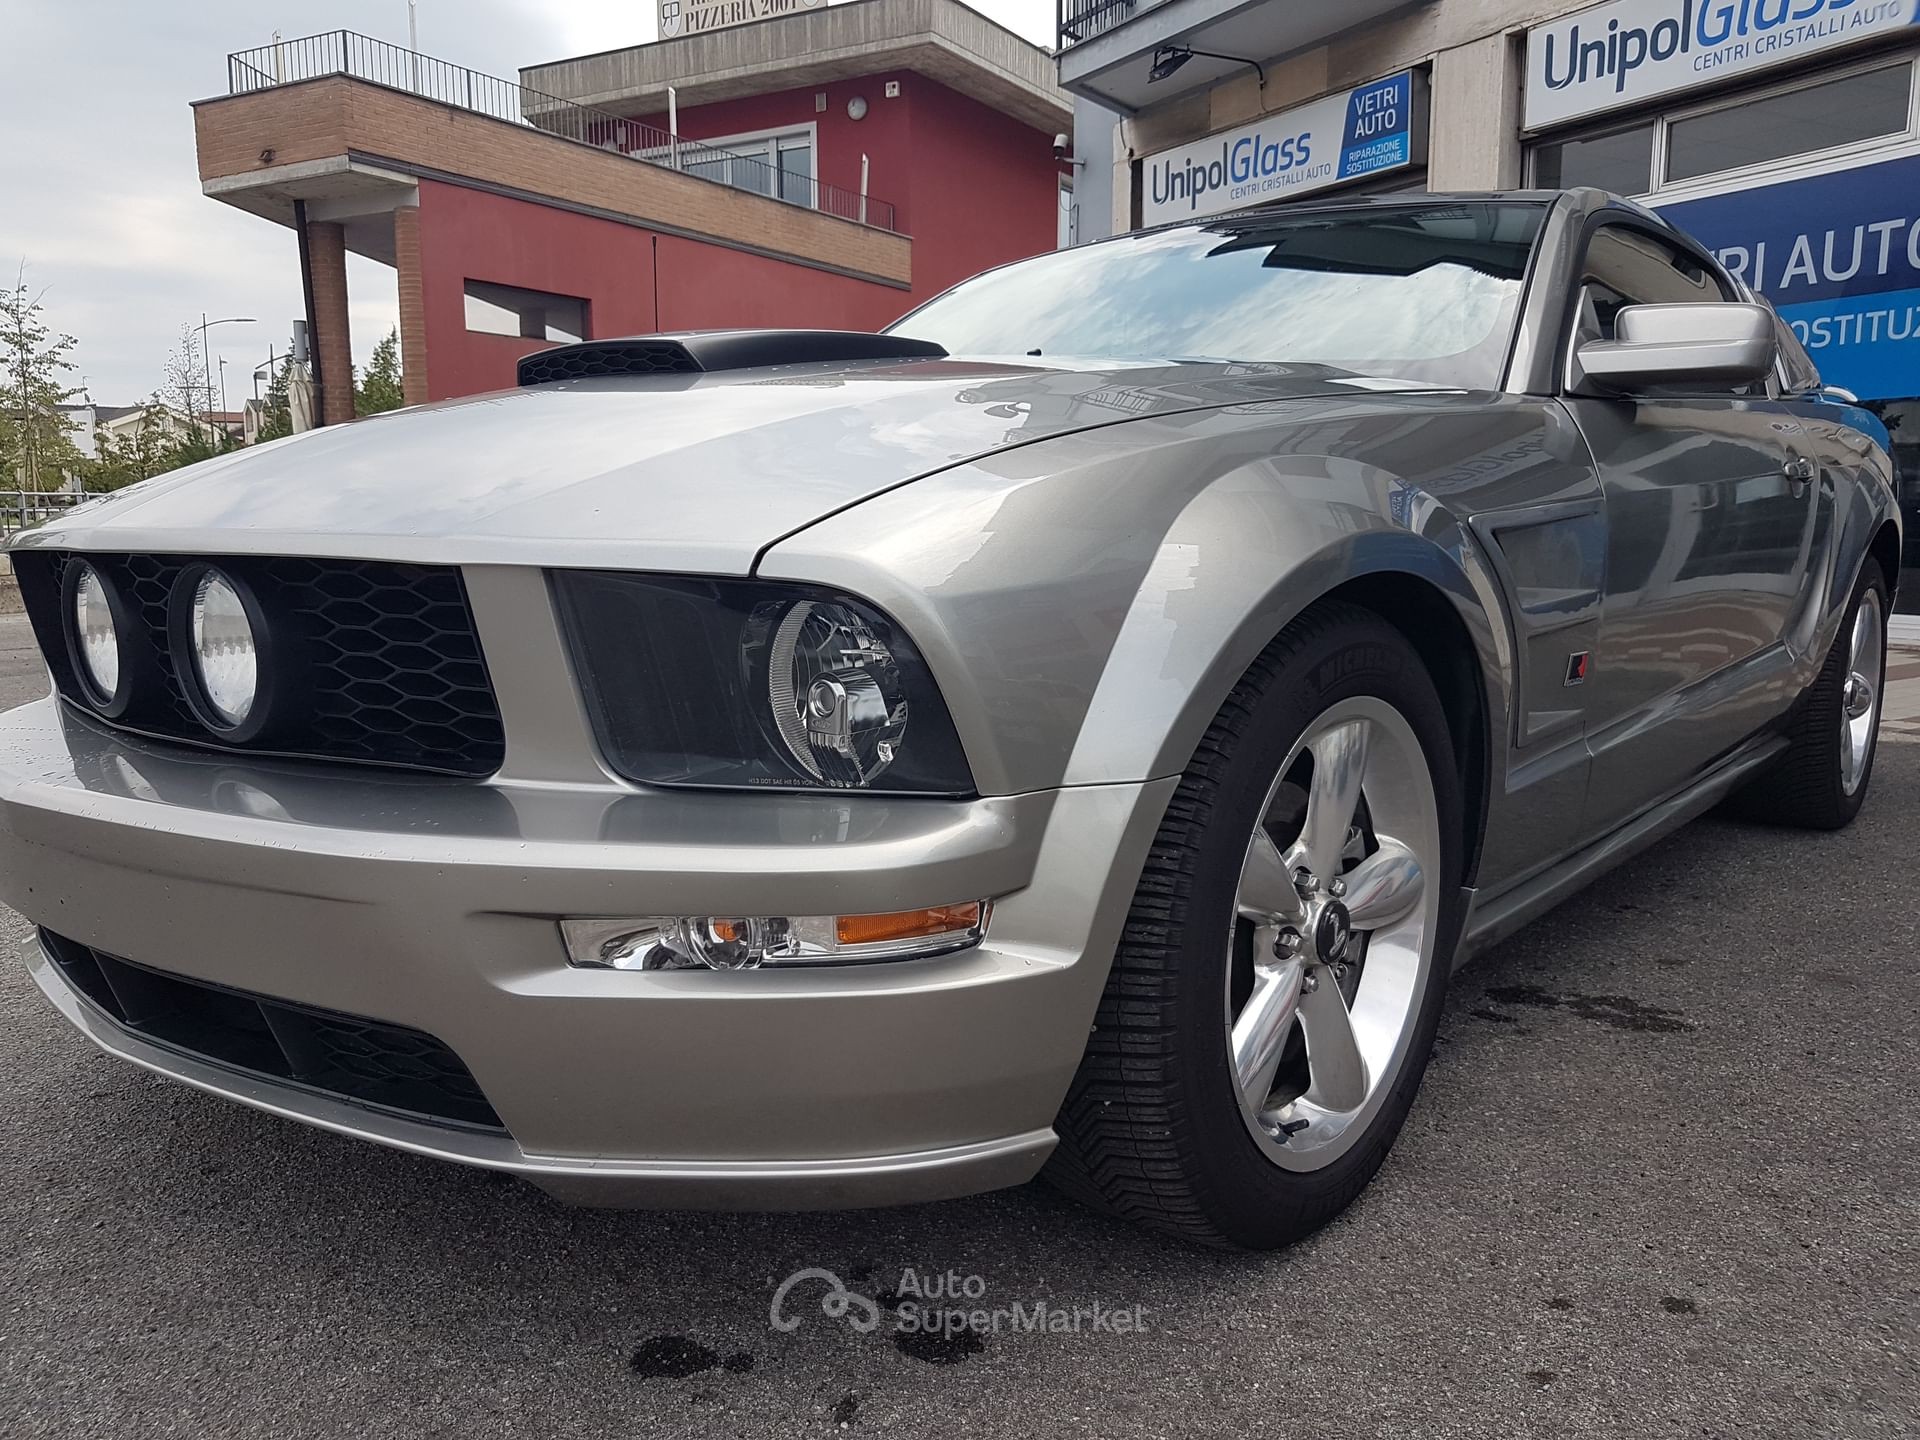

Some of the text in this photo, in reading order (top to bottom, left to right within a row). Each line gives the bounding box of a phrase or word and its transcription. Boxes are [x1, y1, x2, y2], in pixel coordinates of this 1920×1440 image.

[685, 0, 756, 33] PIZZERIA
[1544, 0, 1856, 93] UnipolGla
[1693, 1, 1901, 71] CENTRI CRISTALLI AUTO
[1355, 84, 1399, 115] VETRI
[1354, 108, 1396, 139] AUTO
[1346, 150, 1403, 175] SOSTITUZIONE
[1348, 138, 1401, 162] RIPARAZIONE
[1152, 132, 1312, 210] UnipolGlass
[1230, 162, 1331, 200] CENTRI CRISTALLI AUTO
[1709, 241, 1766, 292] RI
